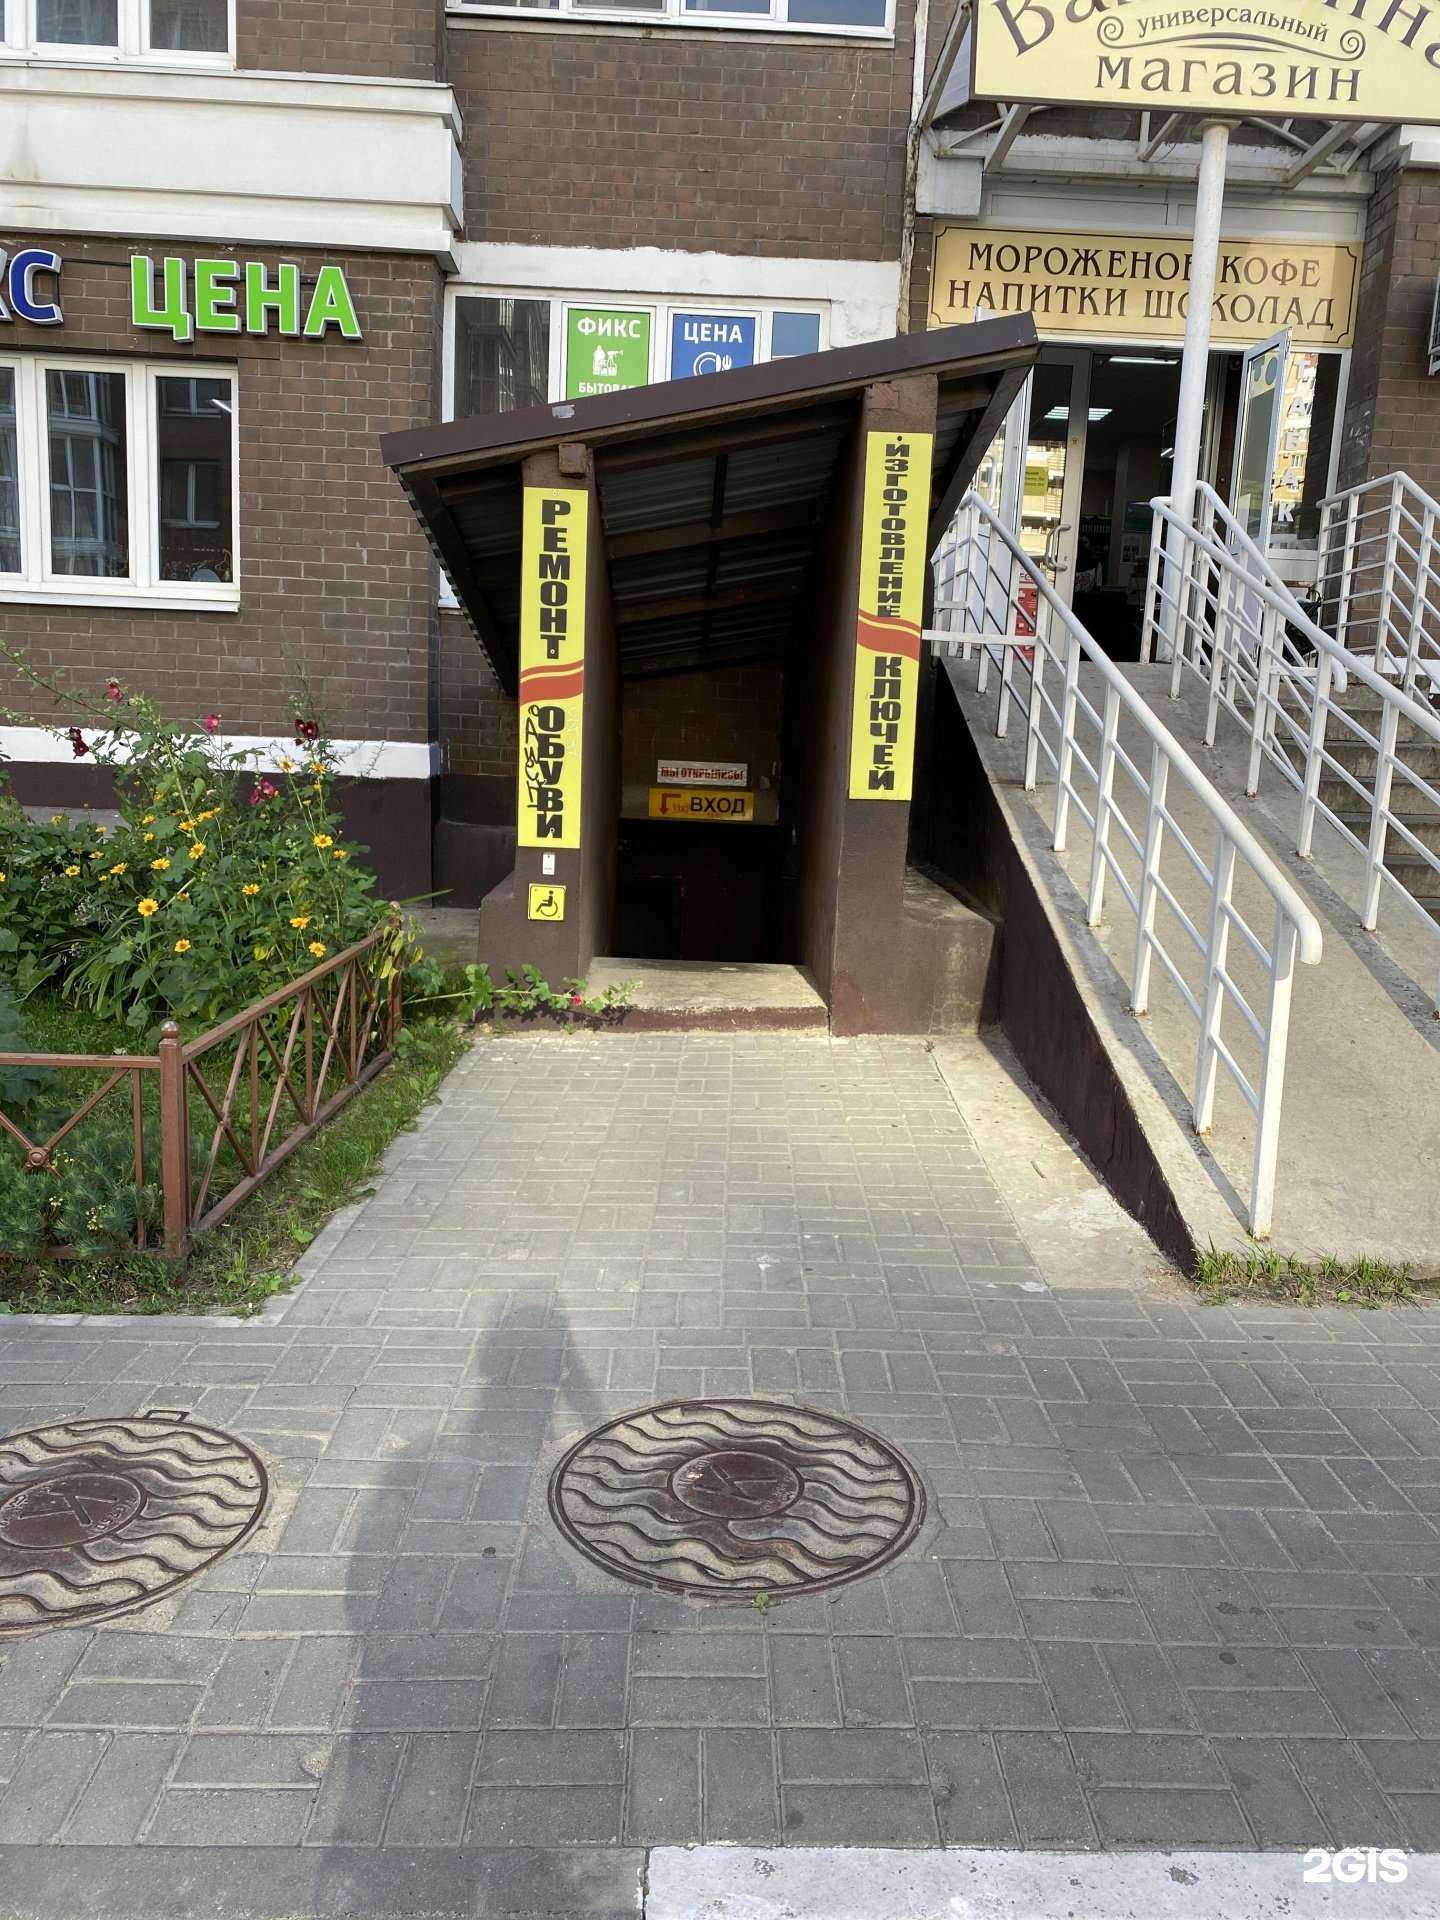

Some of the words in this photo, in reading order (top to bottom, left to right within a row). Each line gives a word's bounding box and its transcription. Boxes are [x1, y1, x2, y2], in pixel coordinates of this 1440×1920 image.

[1136, 7, 1329, 43] универсальный
[1094, 55, 1364, 102] магазин
[1220, 255, 1321, 287] КОФЕ
[130, 255, 362, 342] ЦЕНА
[947, 279, 1128, 316] НАПИТКИ
[577, 316, 641, 339] ФИКС
[684, 322, 743, 344] ЦЕНА
[578, 382, 636, 395] БЫТОВ
[877, 444, 911, 618] ИЗГОТОВЛЕНИЕ
[539, 499, 571, 659] РЕМОНТ
[868, 656, 903, 790] КЛЮЧЕЙ
[537, 705, 565, 839] ОБУВИ
[690, 796, 745, 816] ВХОД
